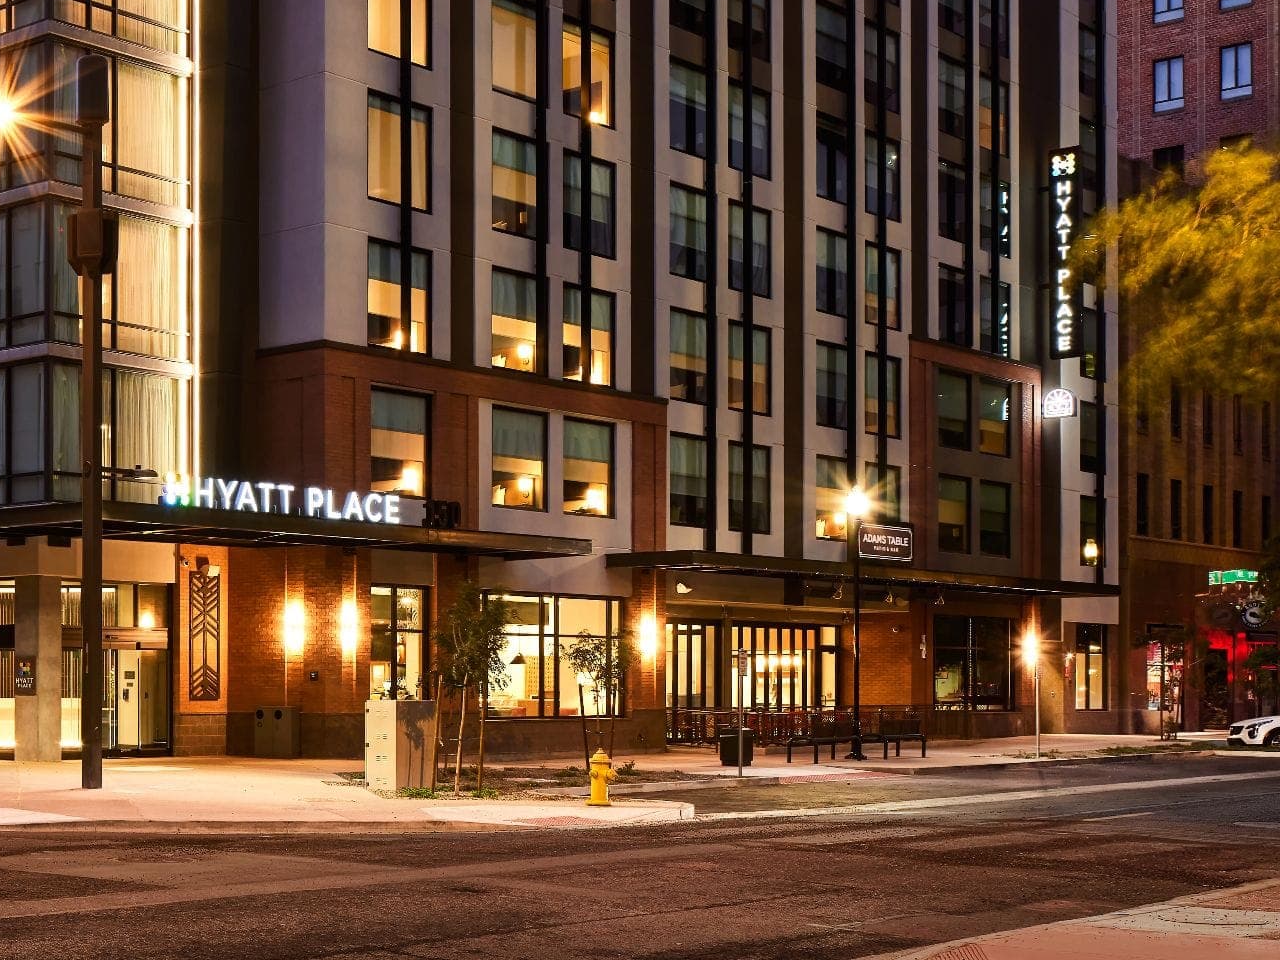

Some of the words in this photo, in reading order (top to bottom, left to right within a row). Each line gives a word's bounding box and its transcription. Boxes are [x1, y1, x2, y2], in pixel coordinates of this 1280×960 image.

[1055, 180, 1072, 260] HYATT
[1056, 269, 1073, 352] PLACE
[194, 477, 295, 515] HYATT
[304, 486, 400, 525] PLACE
[863, 533, 887, 545] ADAMS
[886, 535, 909, 547] TABLE
